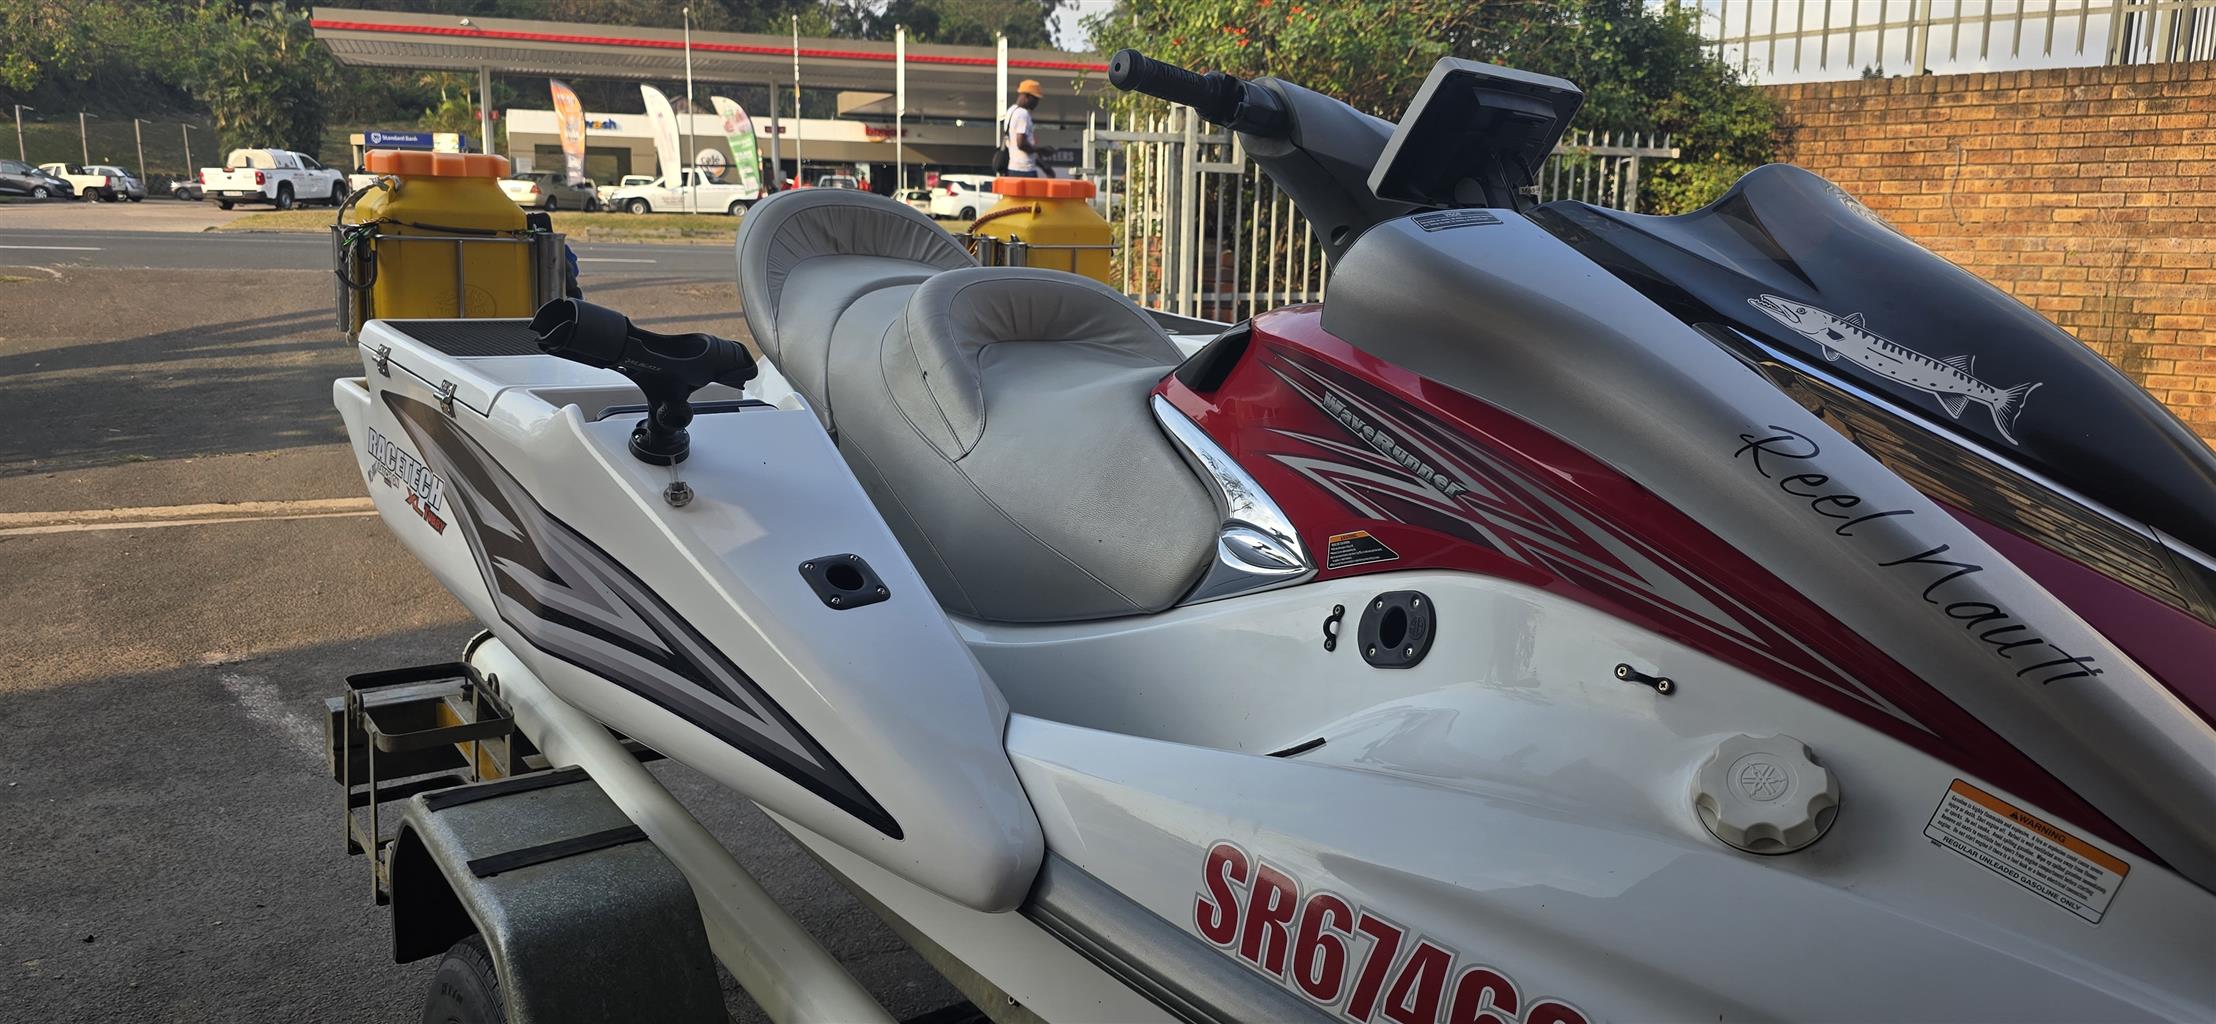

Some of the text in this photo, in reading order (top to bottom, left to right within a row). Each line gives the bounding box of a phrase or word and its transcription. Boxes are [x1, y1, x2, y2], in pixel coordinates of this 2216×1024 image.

[368, 426, 445, 511] RACETECH
[1322, 390, 1467, 498] WaveRunner
[1734, 425, 1914, 536] Reel
[1942, 835, 2081, 911] REGULAR UNLEADED GASOLINE ONLY
[2017, 814, 2066, 843] WARNING
[1193, 839, 1595, 1024] SR6746
